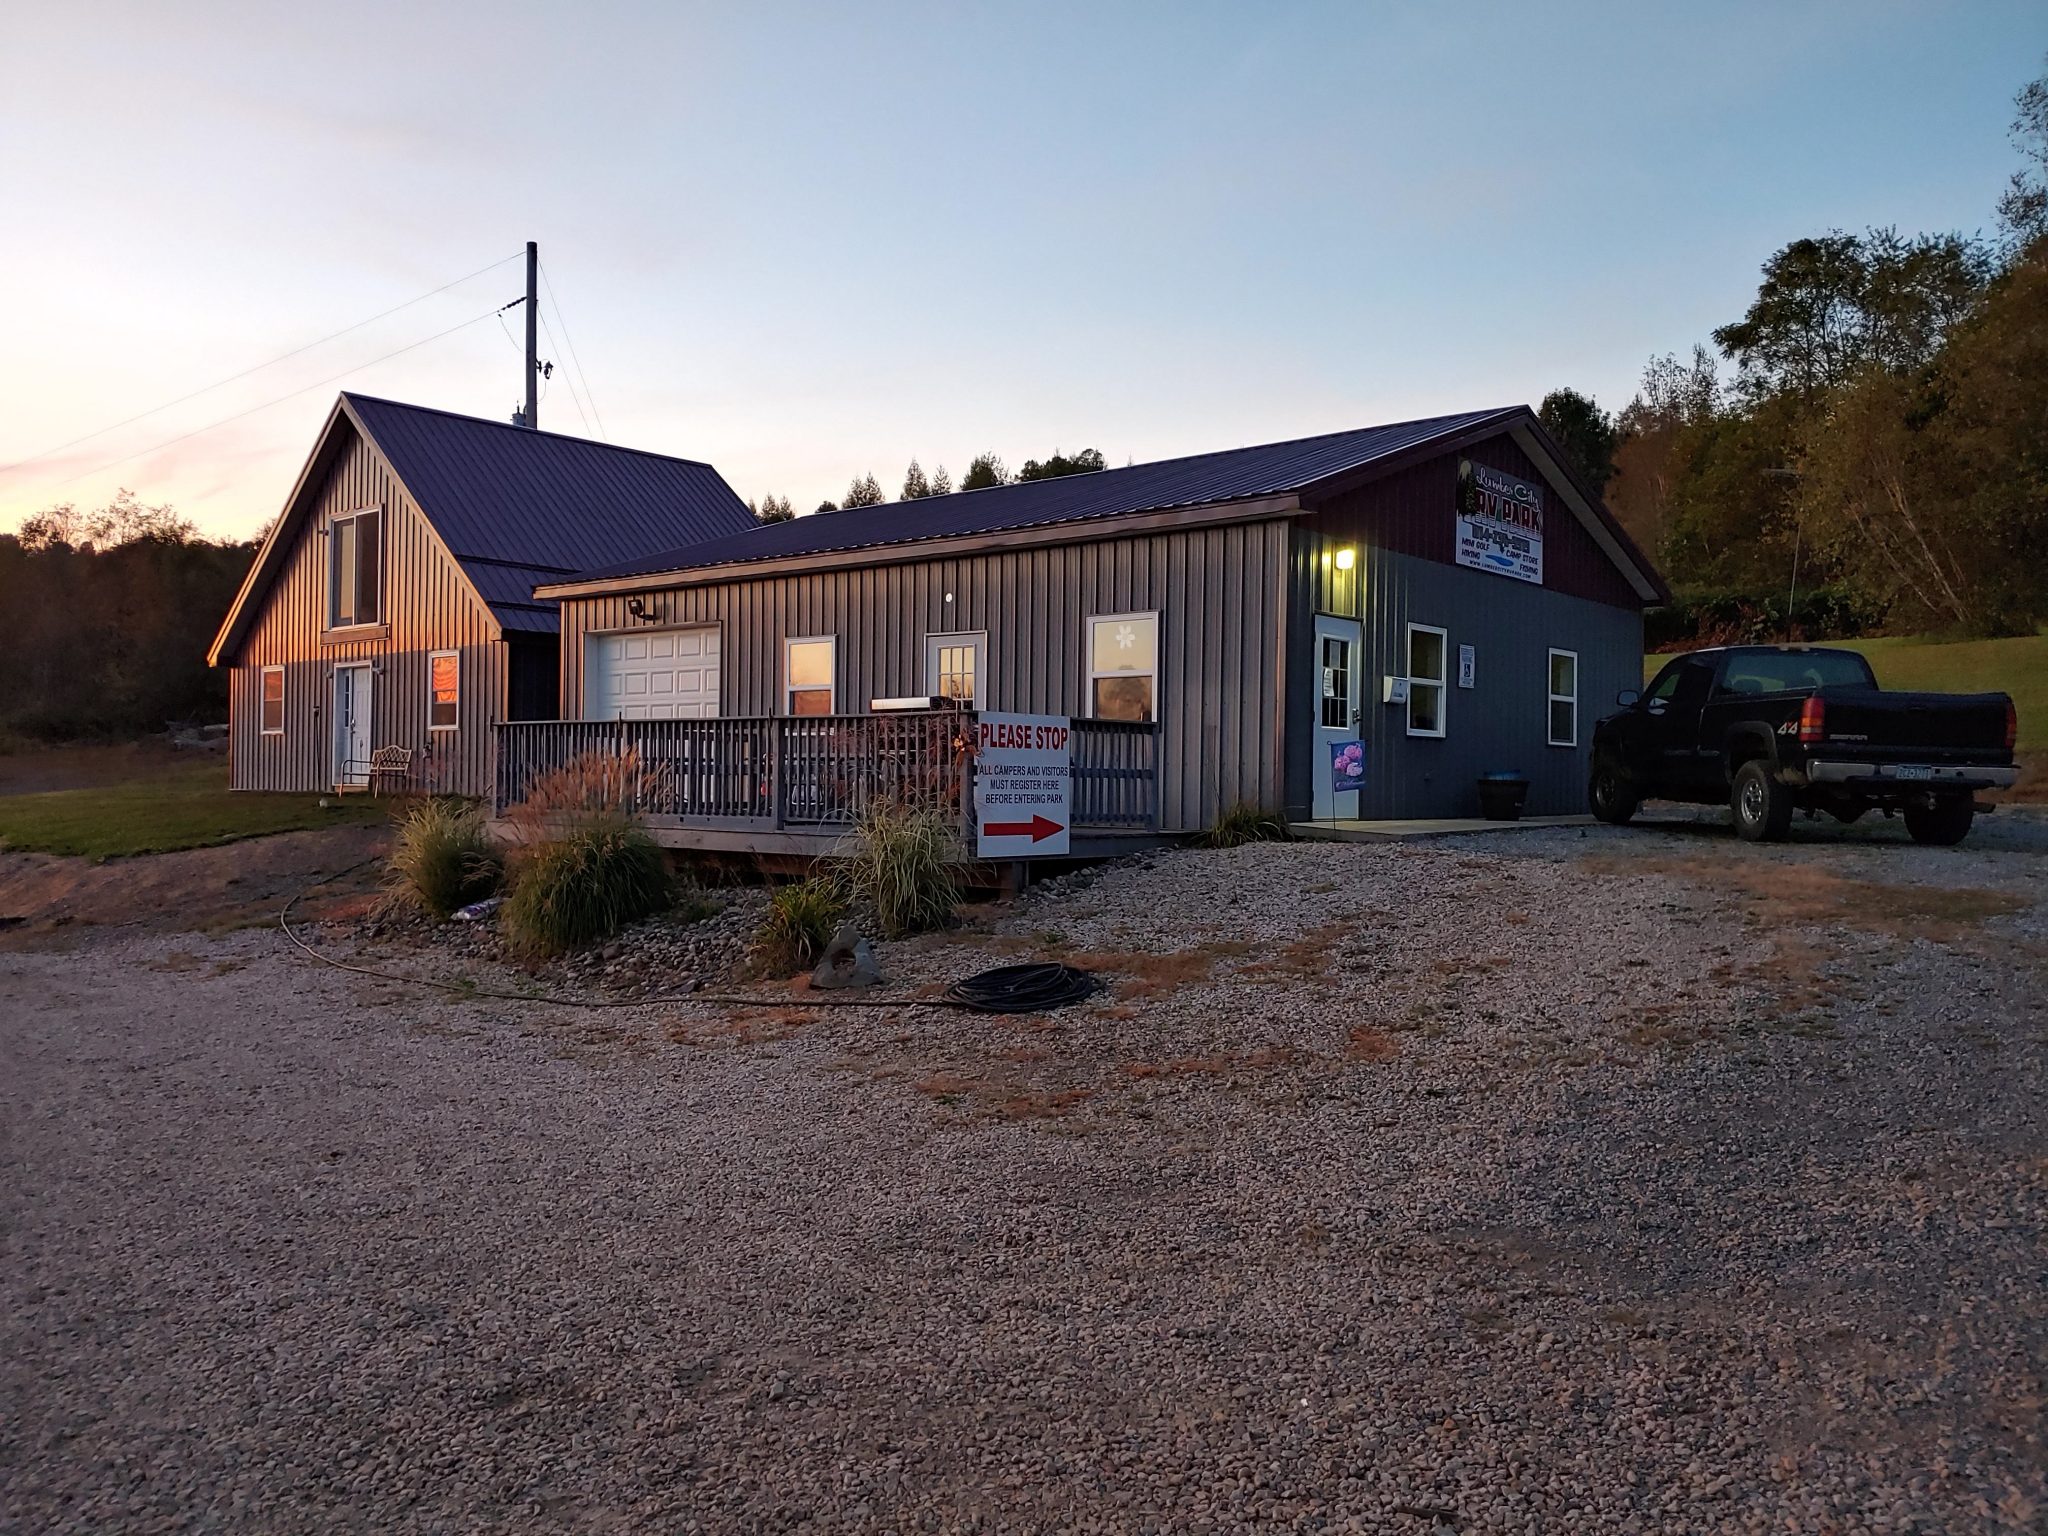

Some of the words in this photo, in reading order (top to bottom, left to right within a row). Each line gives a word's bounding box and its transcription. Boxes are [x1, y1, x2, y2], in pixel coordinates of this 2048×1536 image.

[1476, 467, 1513, 496] Lumber
[1514, 483, 1541, 512] City
[1476, 488, 1498, 518] RV
[1502, 497, 1541, 532] PARK
[1462, 537, 1475, 549] MINI
[1476, 540, 1490, 551] GOLF
[1461, 548, 1480, 560] HIKING
[1506, 550, 1521, 561] CAMP
[1523, 553, 1538, 565] STORE
[1519, 564, 1538, 575] FISHING
[980, 723, 1032, 749] PLEASE
[1035, 726, 1068, 750] STOP
[979, 765, 993, 775] ALL
[994, 765, 1026, 776] CAMPERS
[1027, 766, 1040, 776] AND
[1041, 766, 1068, 776] VISITORS
[990, 779, 1009, 789] MUST
[1010, 780, 1042, 790] REGISTER
[1043, 780, 1059, 790] HERE
[985, 793, 1013, 804] BEFORE
[1014, 794, 1045, 804] ENTERING
[1046, 794, 1063, 804] PARK
